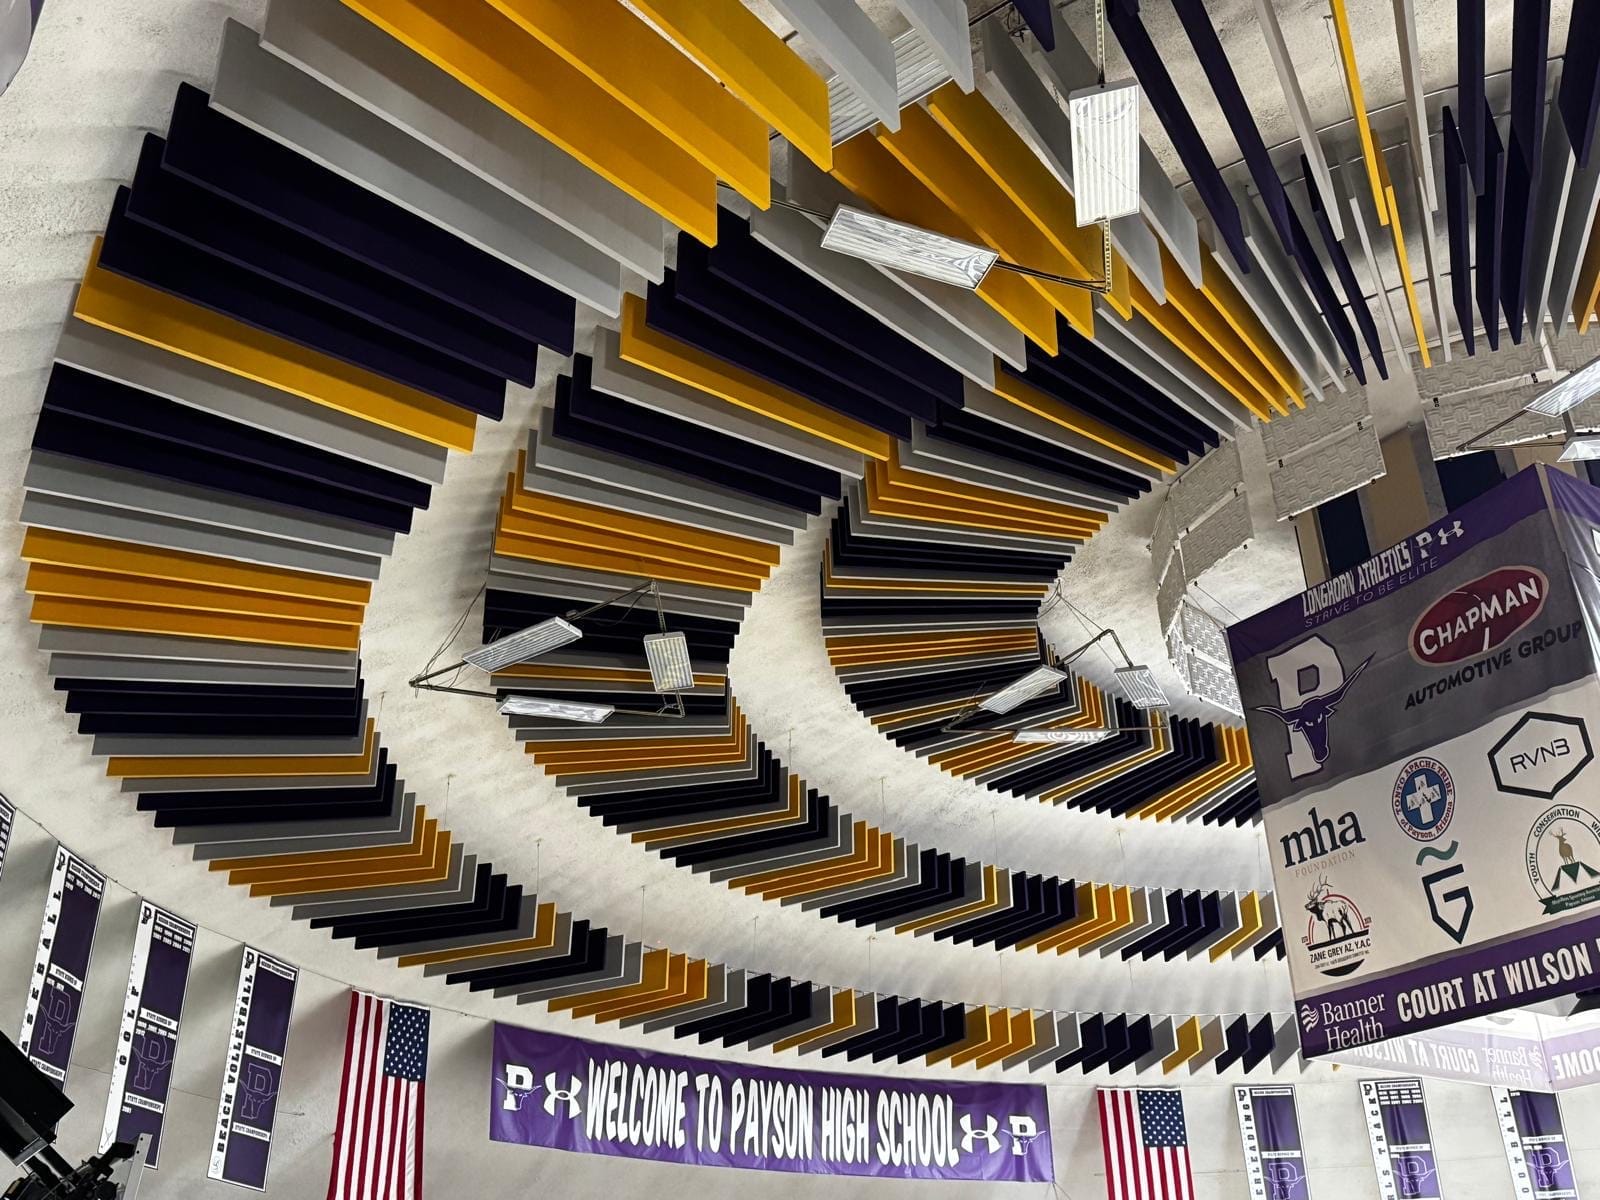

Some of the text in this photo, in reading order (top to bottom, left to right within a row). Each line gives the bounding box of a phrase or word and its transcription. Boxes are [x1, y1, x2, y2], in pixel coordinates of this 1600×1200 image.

[1301, 541, 1412, 618] LONGHORN ATHLETICS
[1304, 557, 1440, 629] STRIVE TO BE ELITE
[1418, 577, 1541, 656] CHAPMAN
[1404, 620, 1583, 711] AUTOMOTIVE GROUP
[1394, 760, 1453, 816] TONTO APACHE TRIBE
[1435, 801, 1453, 834] Arizona
[1279, 806, 1367, 868] mha
[1533, 808, 1580, 838] CONSERVATION
[1294, 849, 1356, 878] FOUNDATION
[1528, 852, 1540, 885] YOUTH
[22, 890, 61, 1052] ASEBALL
[1310, 950, 1327, 964] ZANE
[1327, 946, 1344, 958] GREY
[1396, 942, 1594, 1022] COURT AT WILSON
[119, 985, 139, 1066] GOLF
[1320, 993, 1386, 1026] Banner
[1324, 1016, 1385, 1052] Health
[217, 974, 253, 1152] BEACH VOLLEYBALL
[586, 1057, 960, 1168] WELCOME TO PAYSON HIGH SCHOOL
[1369, 1097, 1386, 1155] TRACK
